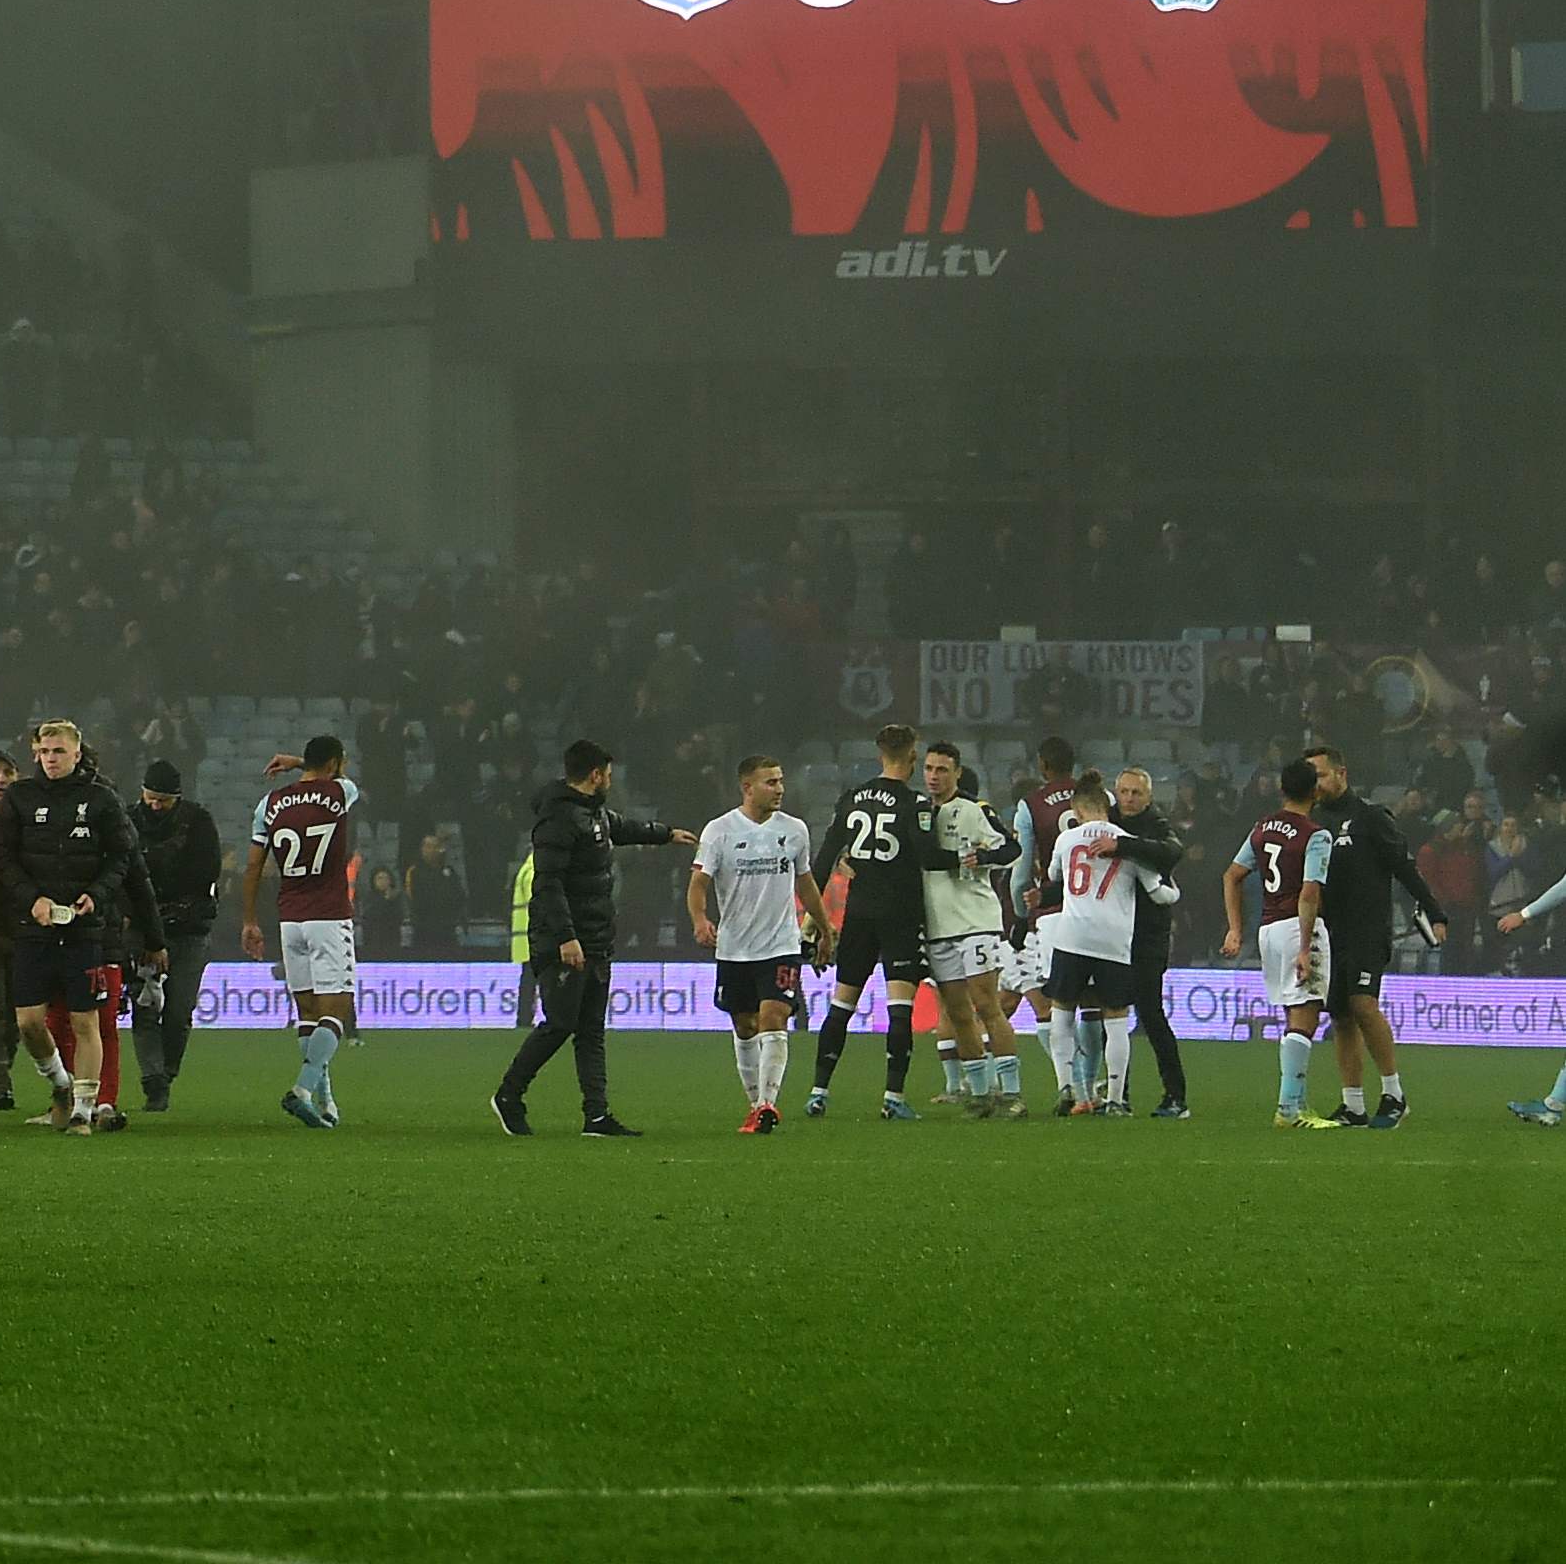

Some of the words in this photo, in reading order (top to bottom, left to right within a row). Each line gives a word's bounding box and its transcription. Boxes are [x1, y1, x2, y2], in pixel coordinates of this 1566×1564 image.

[835, 240, 1008, 278] adi.tv
[929, 643, 989, 673] OUR
[1087, 643, 1195, 674] KNOWS
[929, 678, 991, 721] NO
[265, 791, 348, 828] ELMOHAMADY
[853, 788, 897, 807] NYLAND
[1043, 789, 1075, 807] WES
[846, 809, 900, 862] 25
[1262, 819, 1298, 840] TAYLOR
[273, 822, 338, 878] 27
[1263, 842, 1283, 893] 3
[974, 945, 988, 966] 5
[355, 978, 517, 1016] hildren's
[608, 980, 697, 1029] pital
[1413, 991, 1504, 1034] Partner
[1513, 996, 1541, 1033] of
